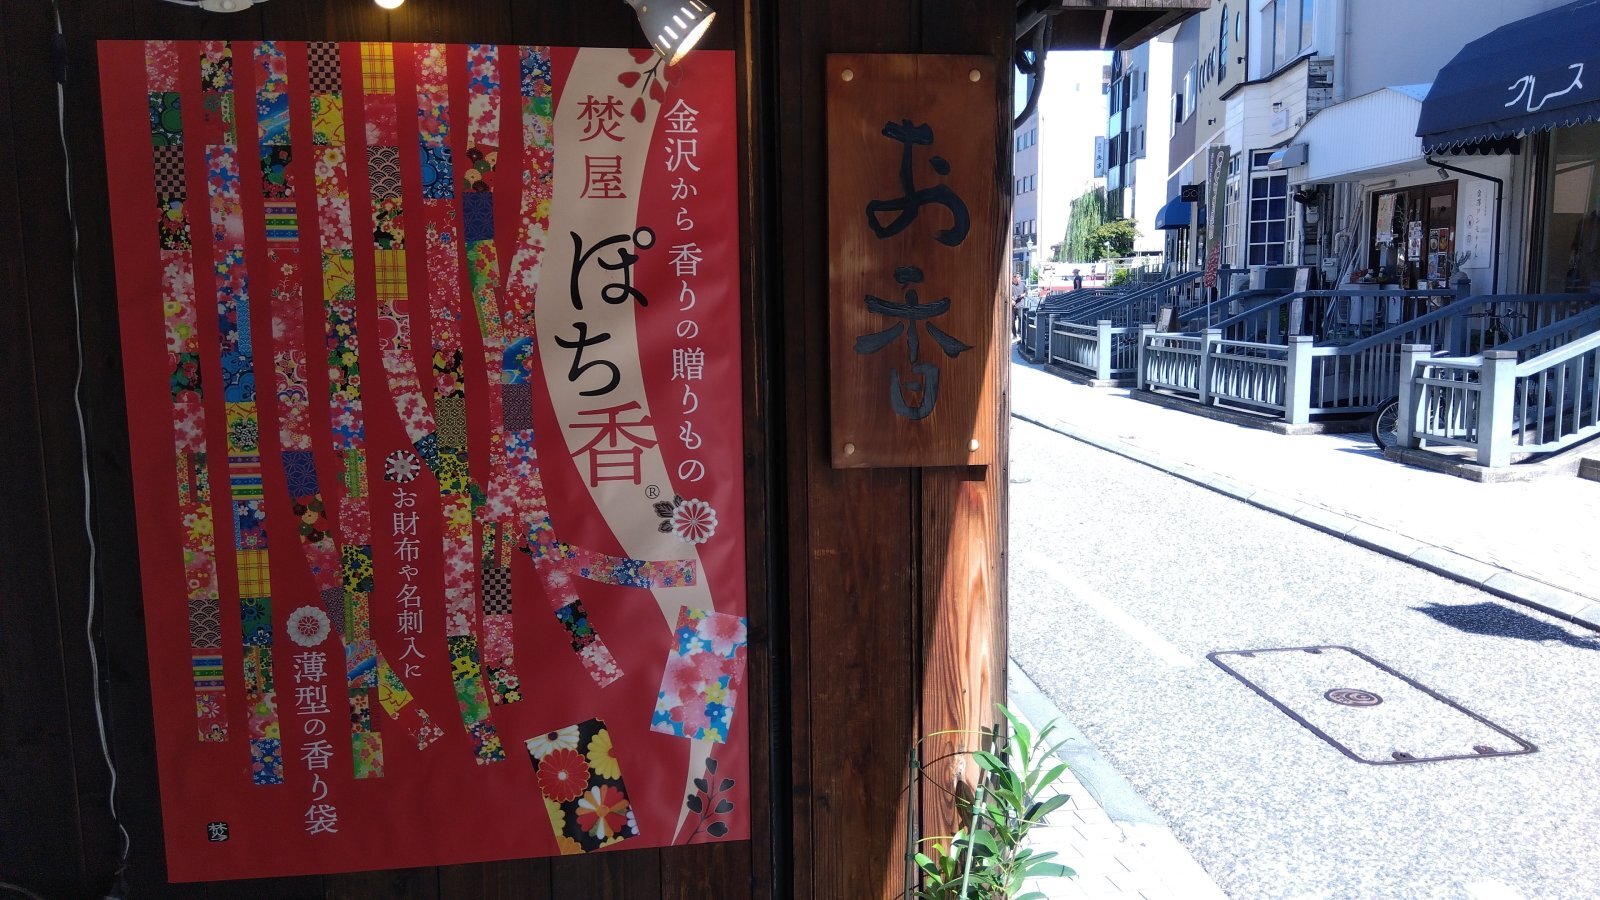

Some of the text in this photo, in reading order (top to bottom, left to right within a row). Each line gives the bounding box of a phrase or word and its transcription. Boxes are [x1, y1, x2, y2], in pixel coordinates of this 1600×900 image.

[576, 94, 627, 199] 焚屋
[554, 226, 659, 488] ぽち香
[663, 98, 705, 483] 金沢から香りの贈りもの
[853, 119, 976, 421] お香
[391, 487, 427, 679] お財布や名刺入に
[292, 651, 339, 836] 薄型の香り袋
